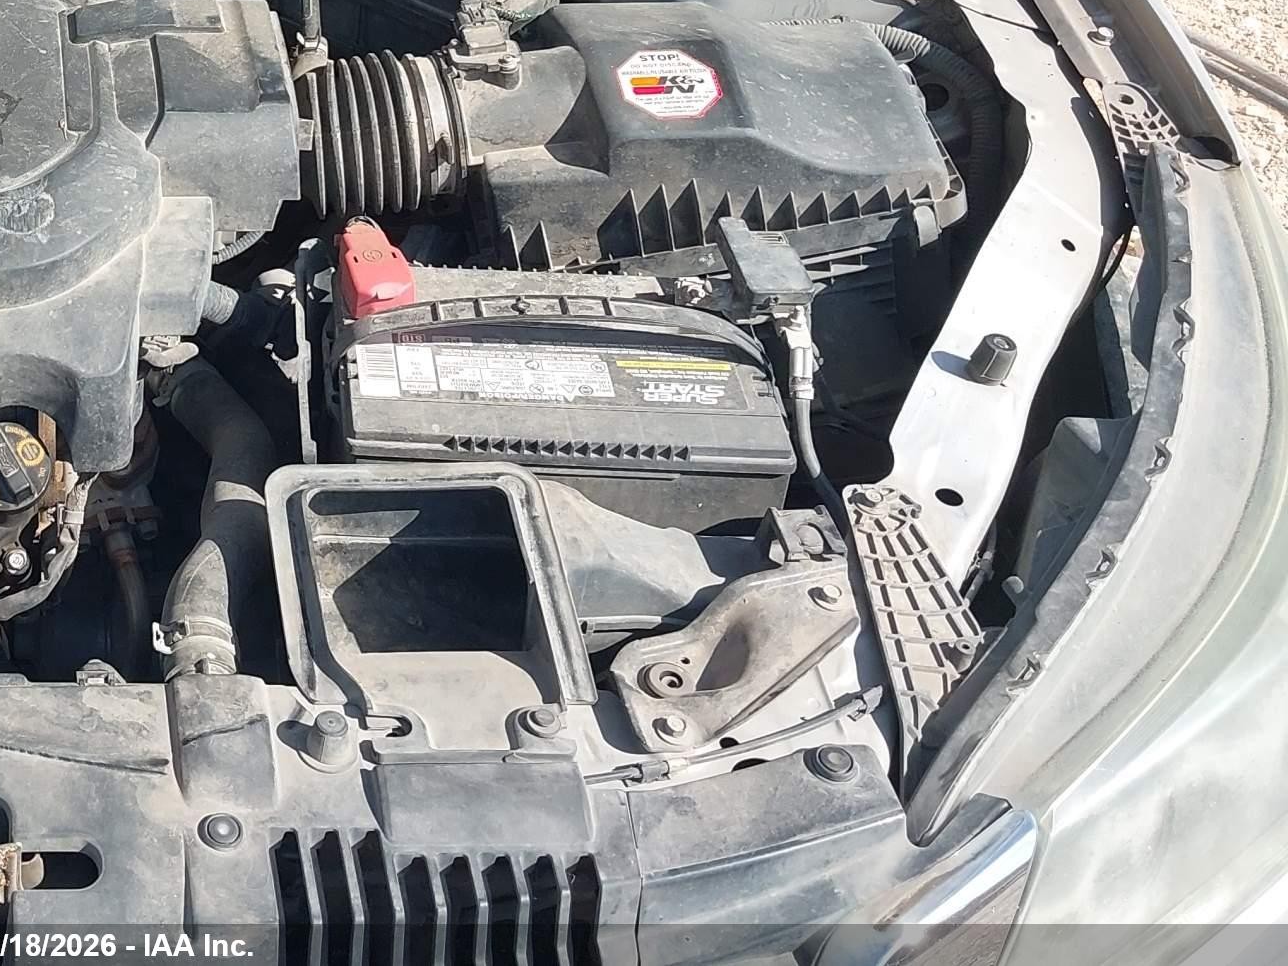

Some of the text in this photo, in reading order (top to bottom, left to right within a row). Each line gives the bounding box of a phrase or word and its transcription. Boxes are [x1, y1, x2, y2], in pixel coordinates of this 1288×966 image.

[639, 53, 680, 62] STOP!
[638, 381, 725, 397] START
[643, 390, 718, 405] SUPER
